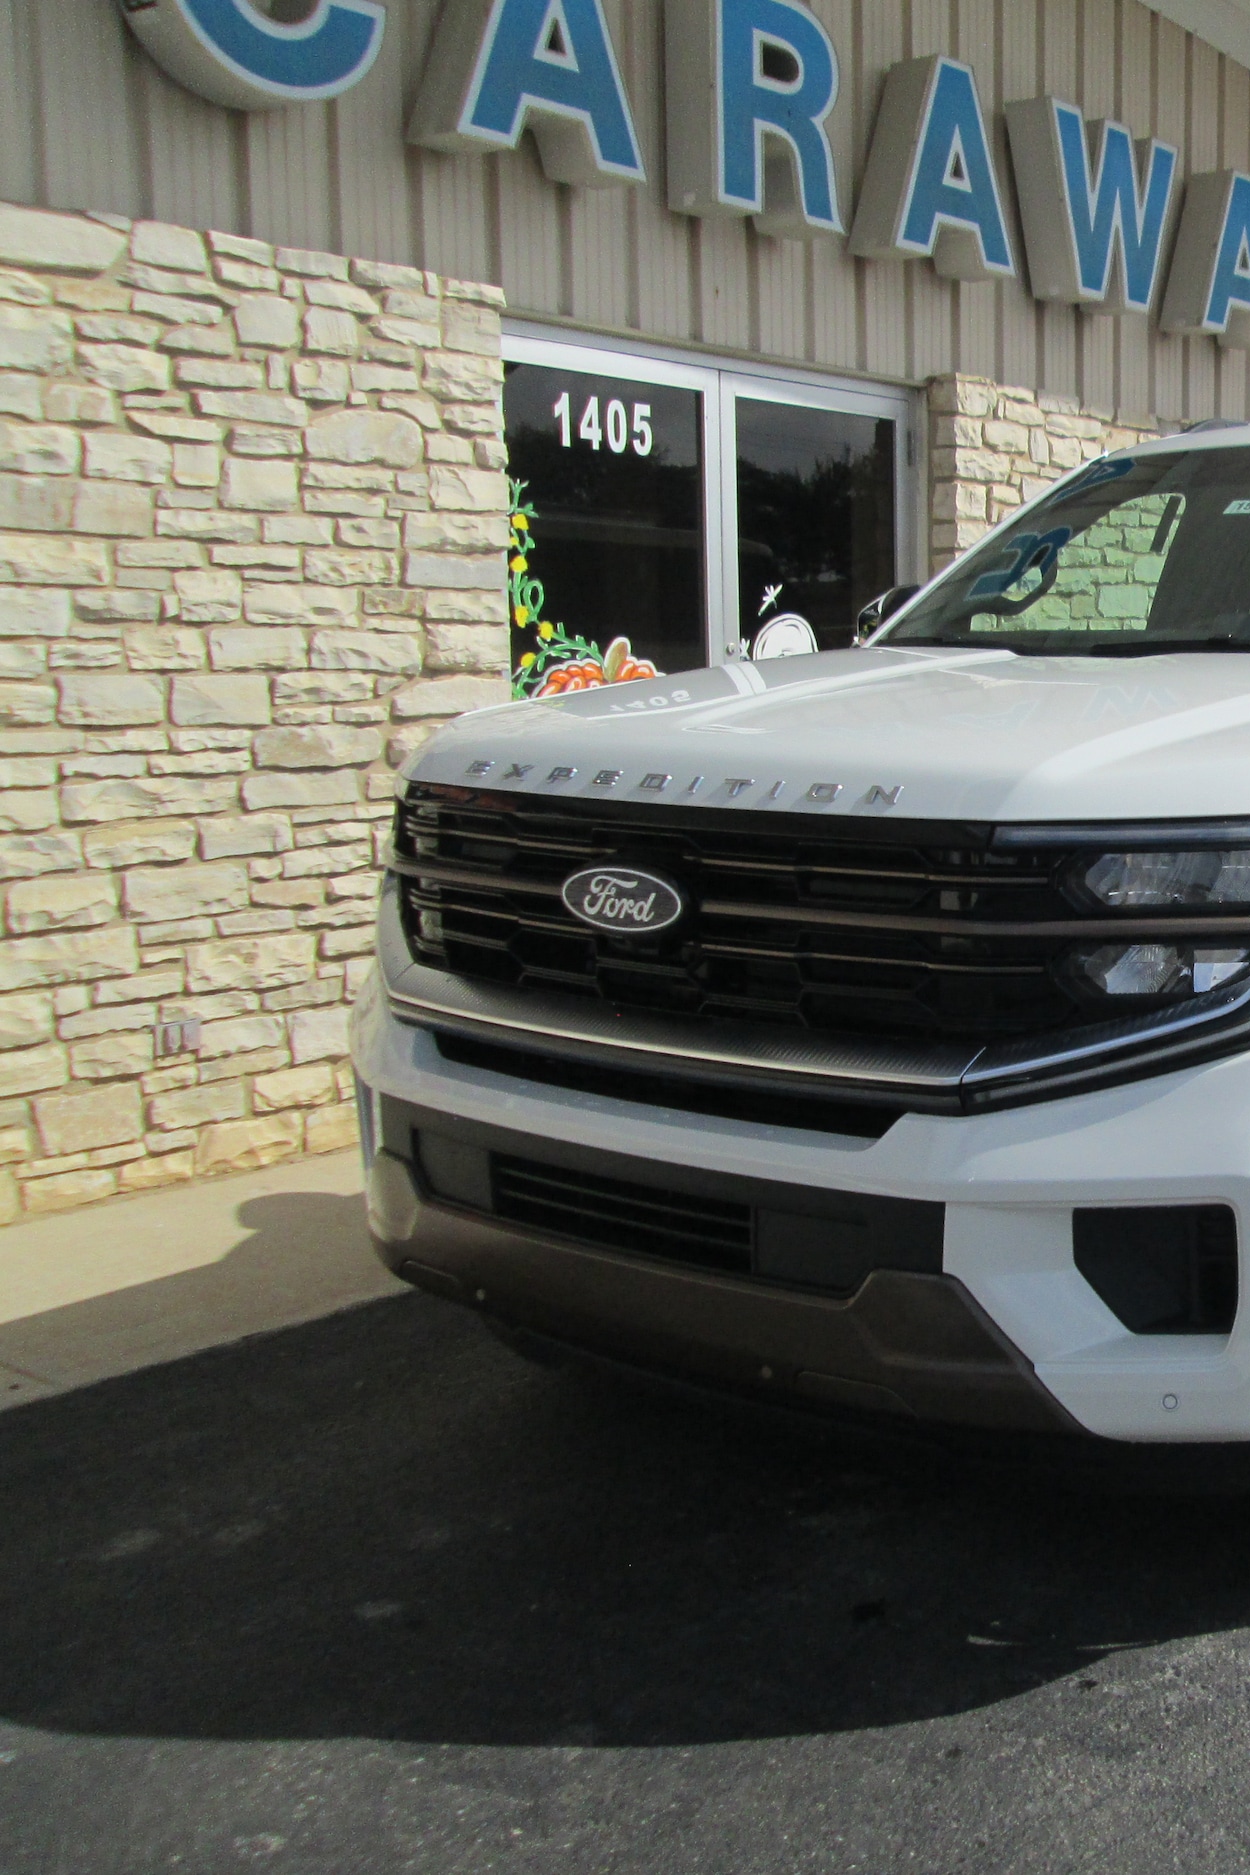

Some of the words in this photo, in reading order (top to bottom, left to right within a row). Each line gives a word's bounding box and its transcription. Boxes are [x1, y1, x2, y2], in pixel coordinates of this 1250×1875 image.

[552, 391, 653, 457] 1405
[464, 760, 905, 806] EXPEDITION
[583, 875, 657, 922] Ford
